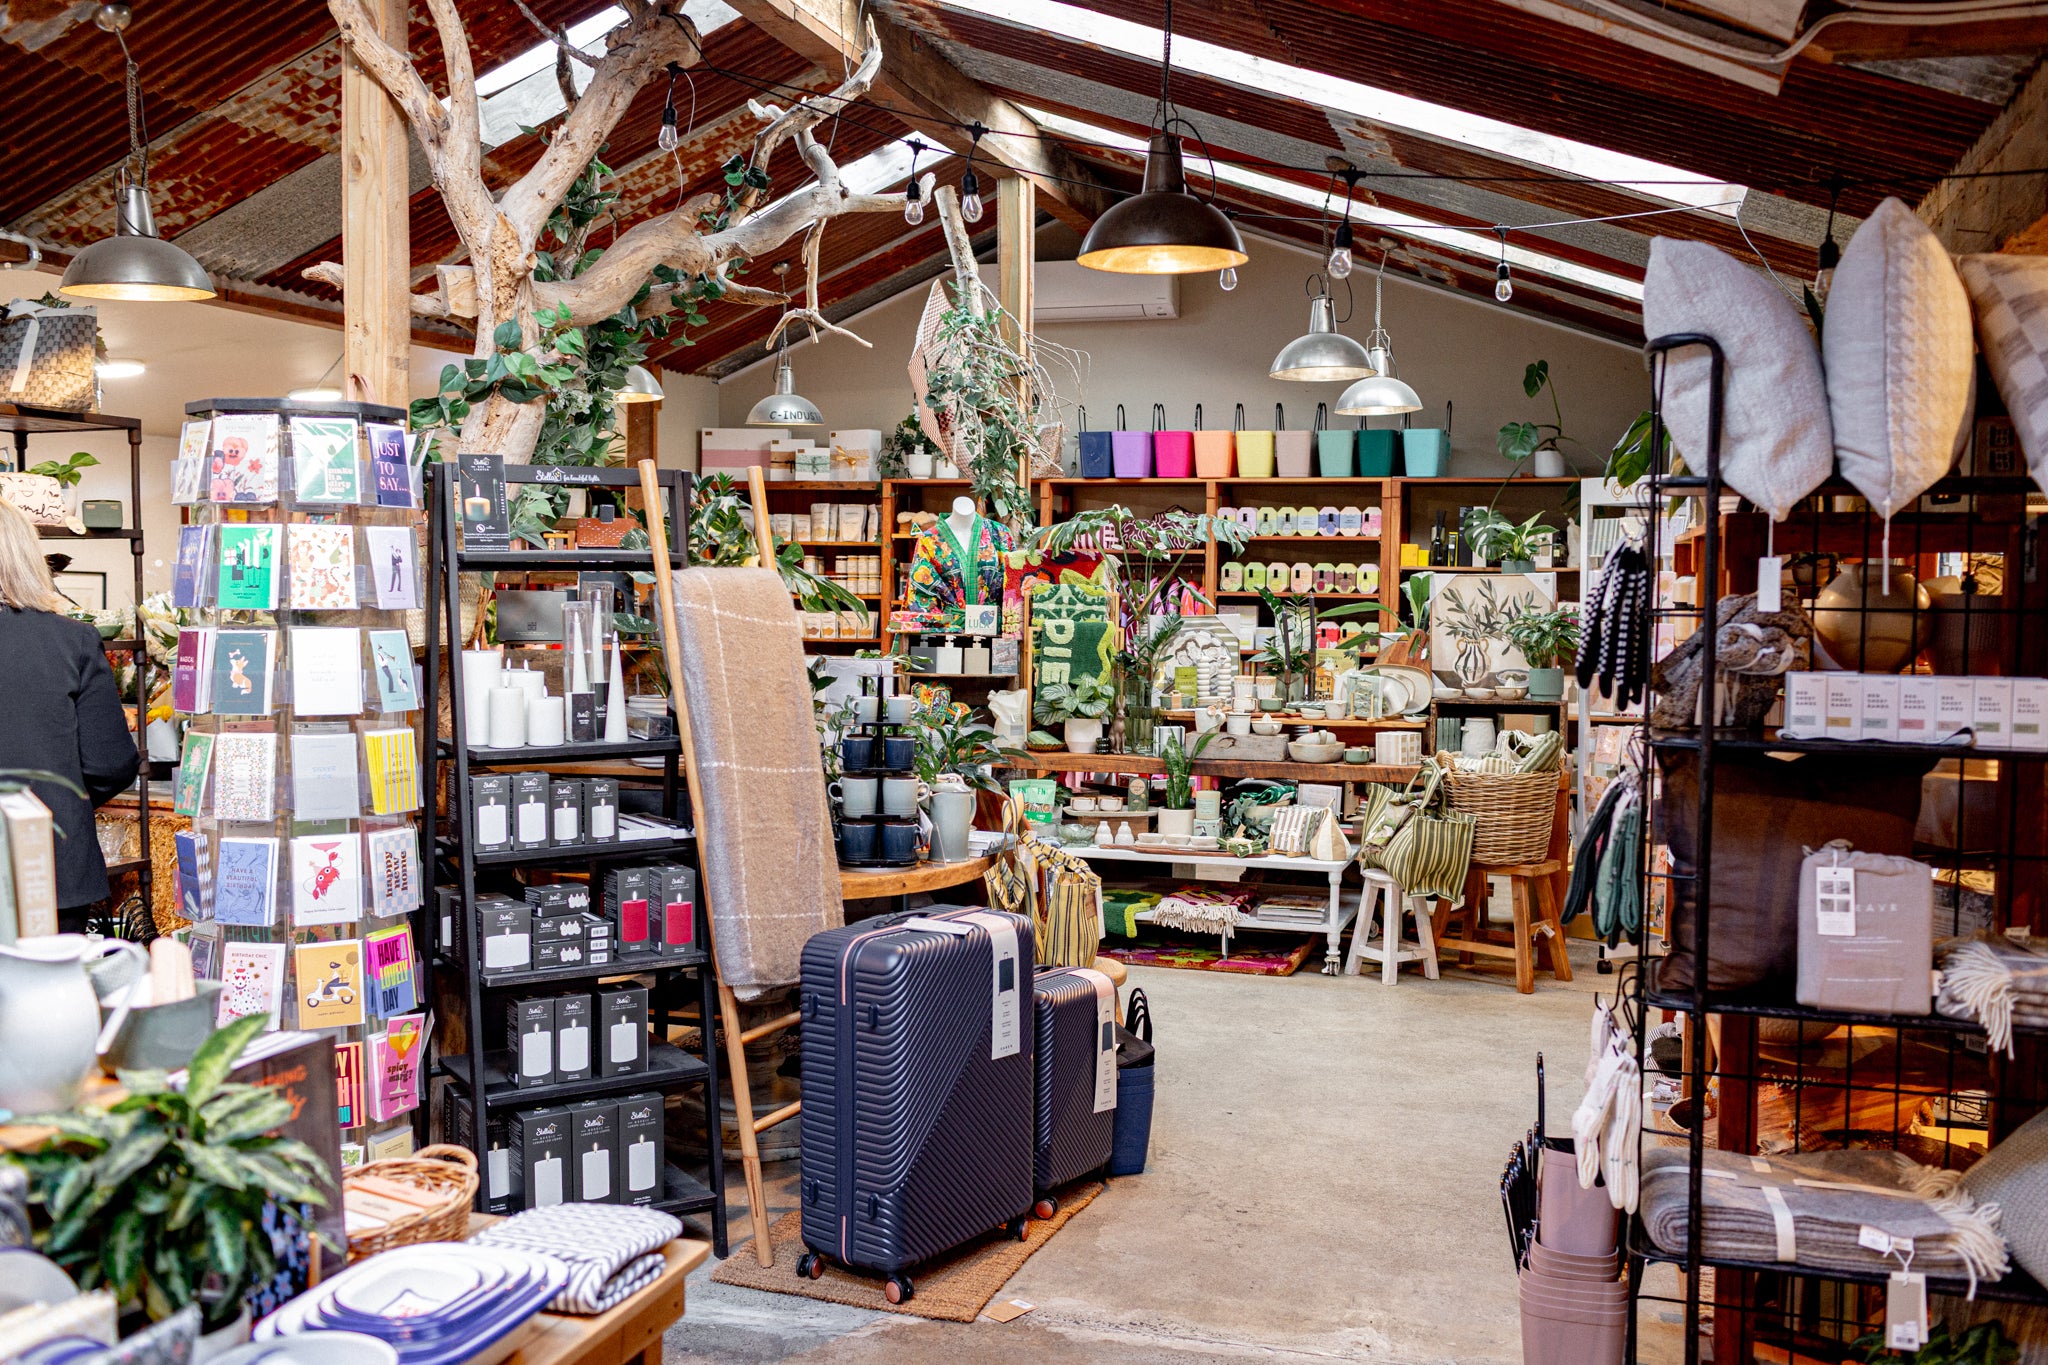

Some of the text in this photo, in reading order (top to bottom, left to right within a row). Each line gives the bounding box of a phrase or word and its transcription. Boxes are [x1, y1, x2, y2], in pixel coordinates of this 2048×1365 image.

[375, 442, 400, 458] JUST
[377, 462, 394, 476] TO
[377, 940, 400, 966] HAVE
[380, 959, 408, 990] LOVELY
[382, 986, 398, 1012] DAY
[387, 1063, 408, 1074] spicy
[388, 1070, 413, 1082] marg?
[630, 1110, 649, 1120] Stella
[584, 1118, 602, 1128] Stella
[536, 1126, 554, 1136] Stella
